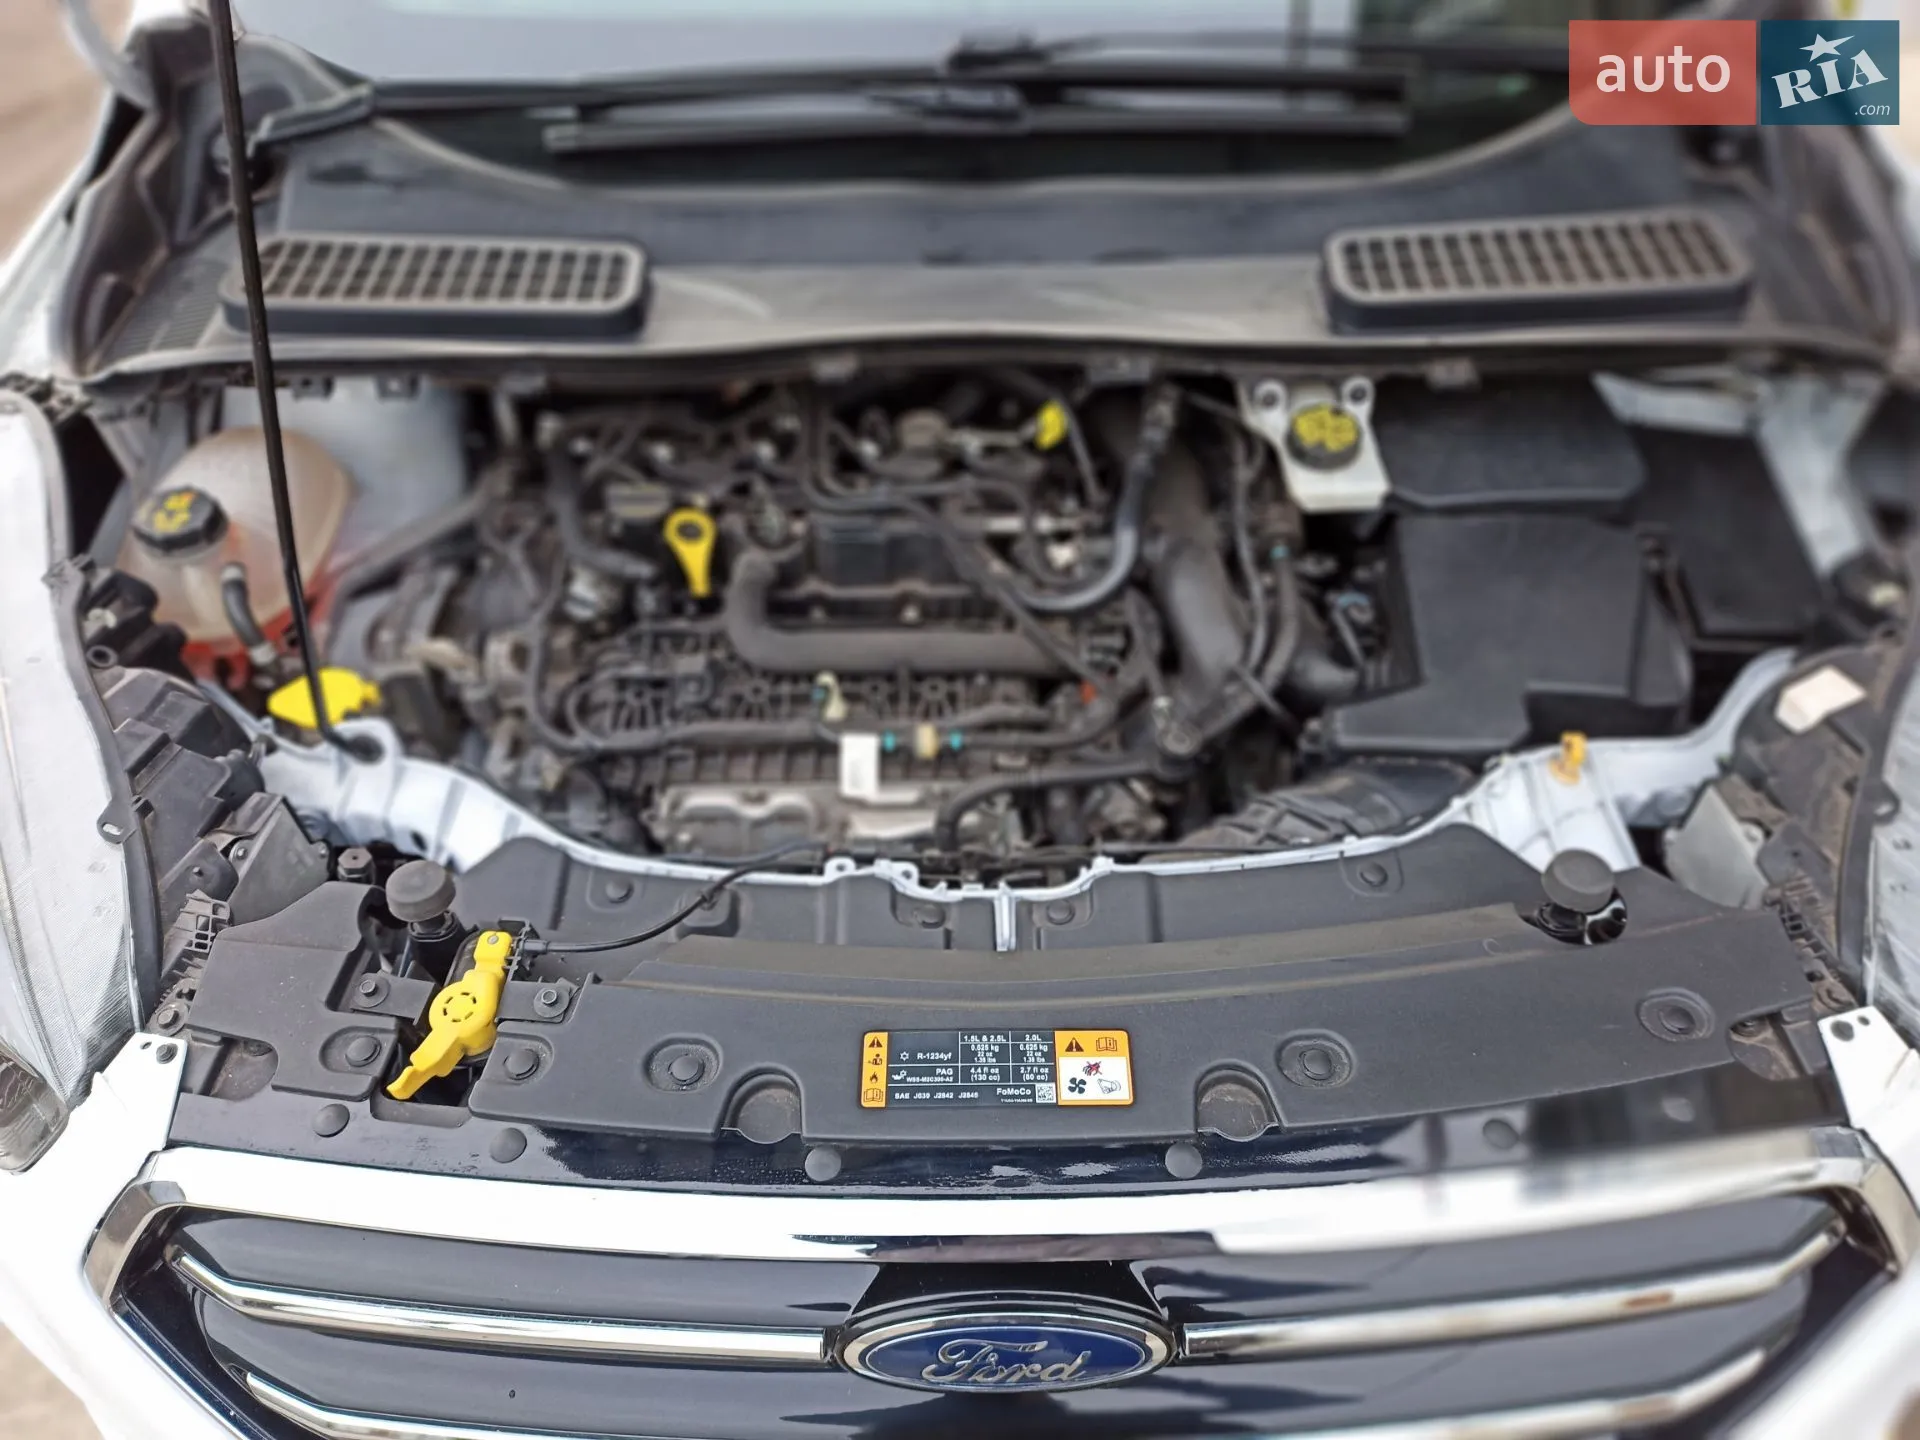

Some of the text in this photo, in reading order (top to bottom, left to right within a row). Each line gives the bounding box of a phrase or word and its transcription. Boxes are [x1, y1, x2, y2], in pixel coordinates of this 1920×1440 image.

[990, 1044, 1000, 1053] kg
[1039, 1043, 1048, 1053] kg
[917, 1052, 952, 1061] R-1234yf
[935, 1068, 954, 1076] PAG
[970, 1074, 987, 1082] (130
[996, 1087, 1032, 1096] FoMoCo
[921, 1338, 1093, 1383] Ford
